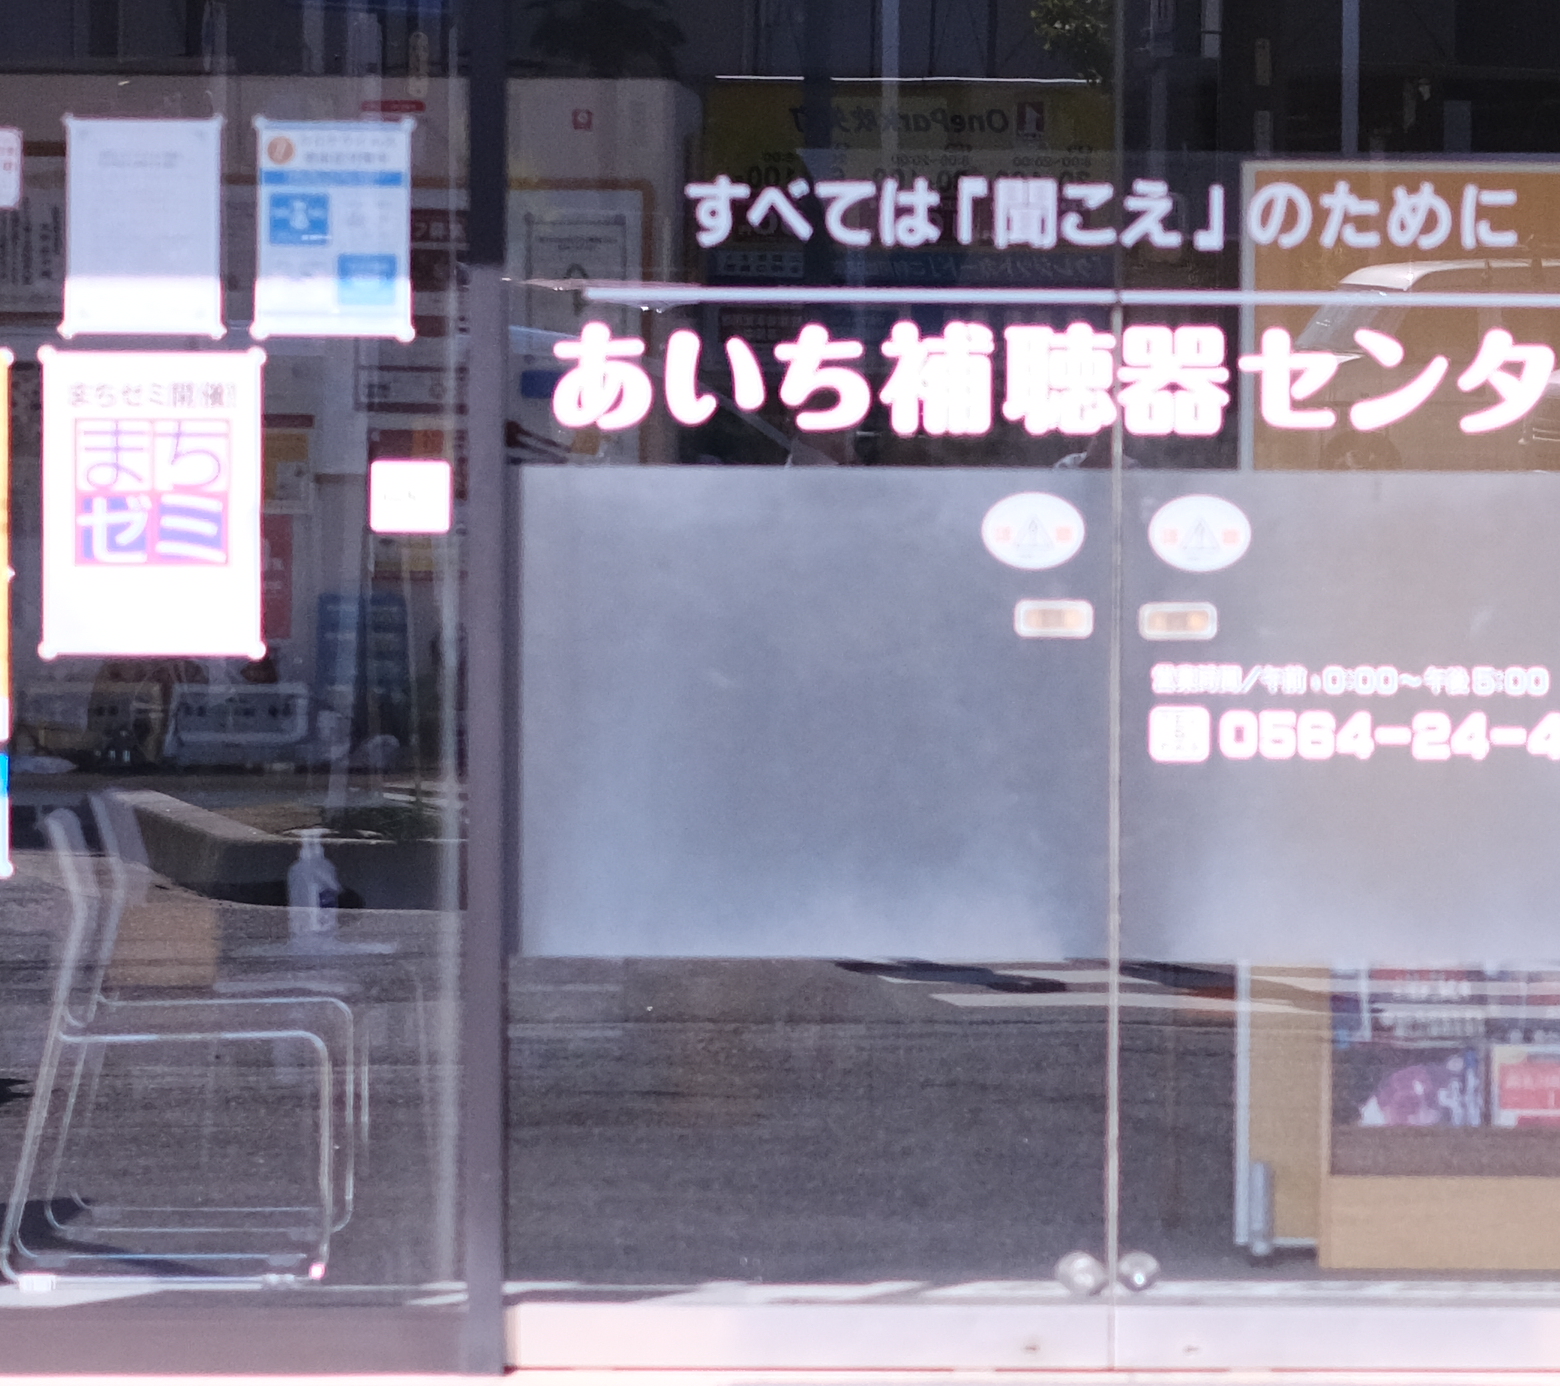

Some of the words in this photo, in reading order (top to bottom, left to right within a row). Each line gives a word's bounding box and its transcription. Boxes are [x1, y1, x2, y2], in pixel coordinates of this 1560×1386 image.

[684, 175, 1521, 253] すべては「聞こえ」のために
